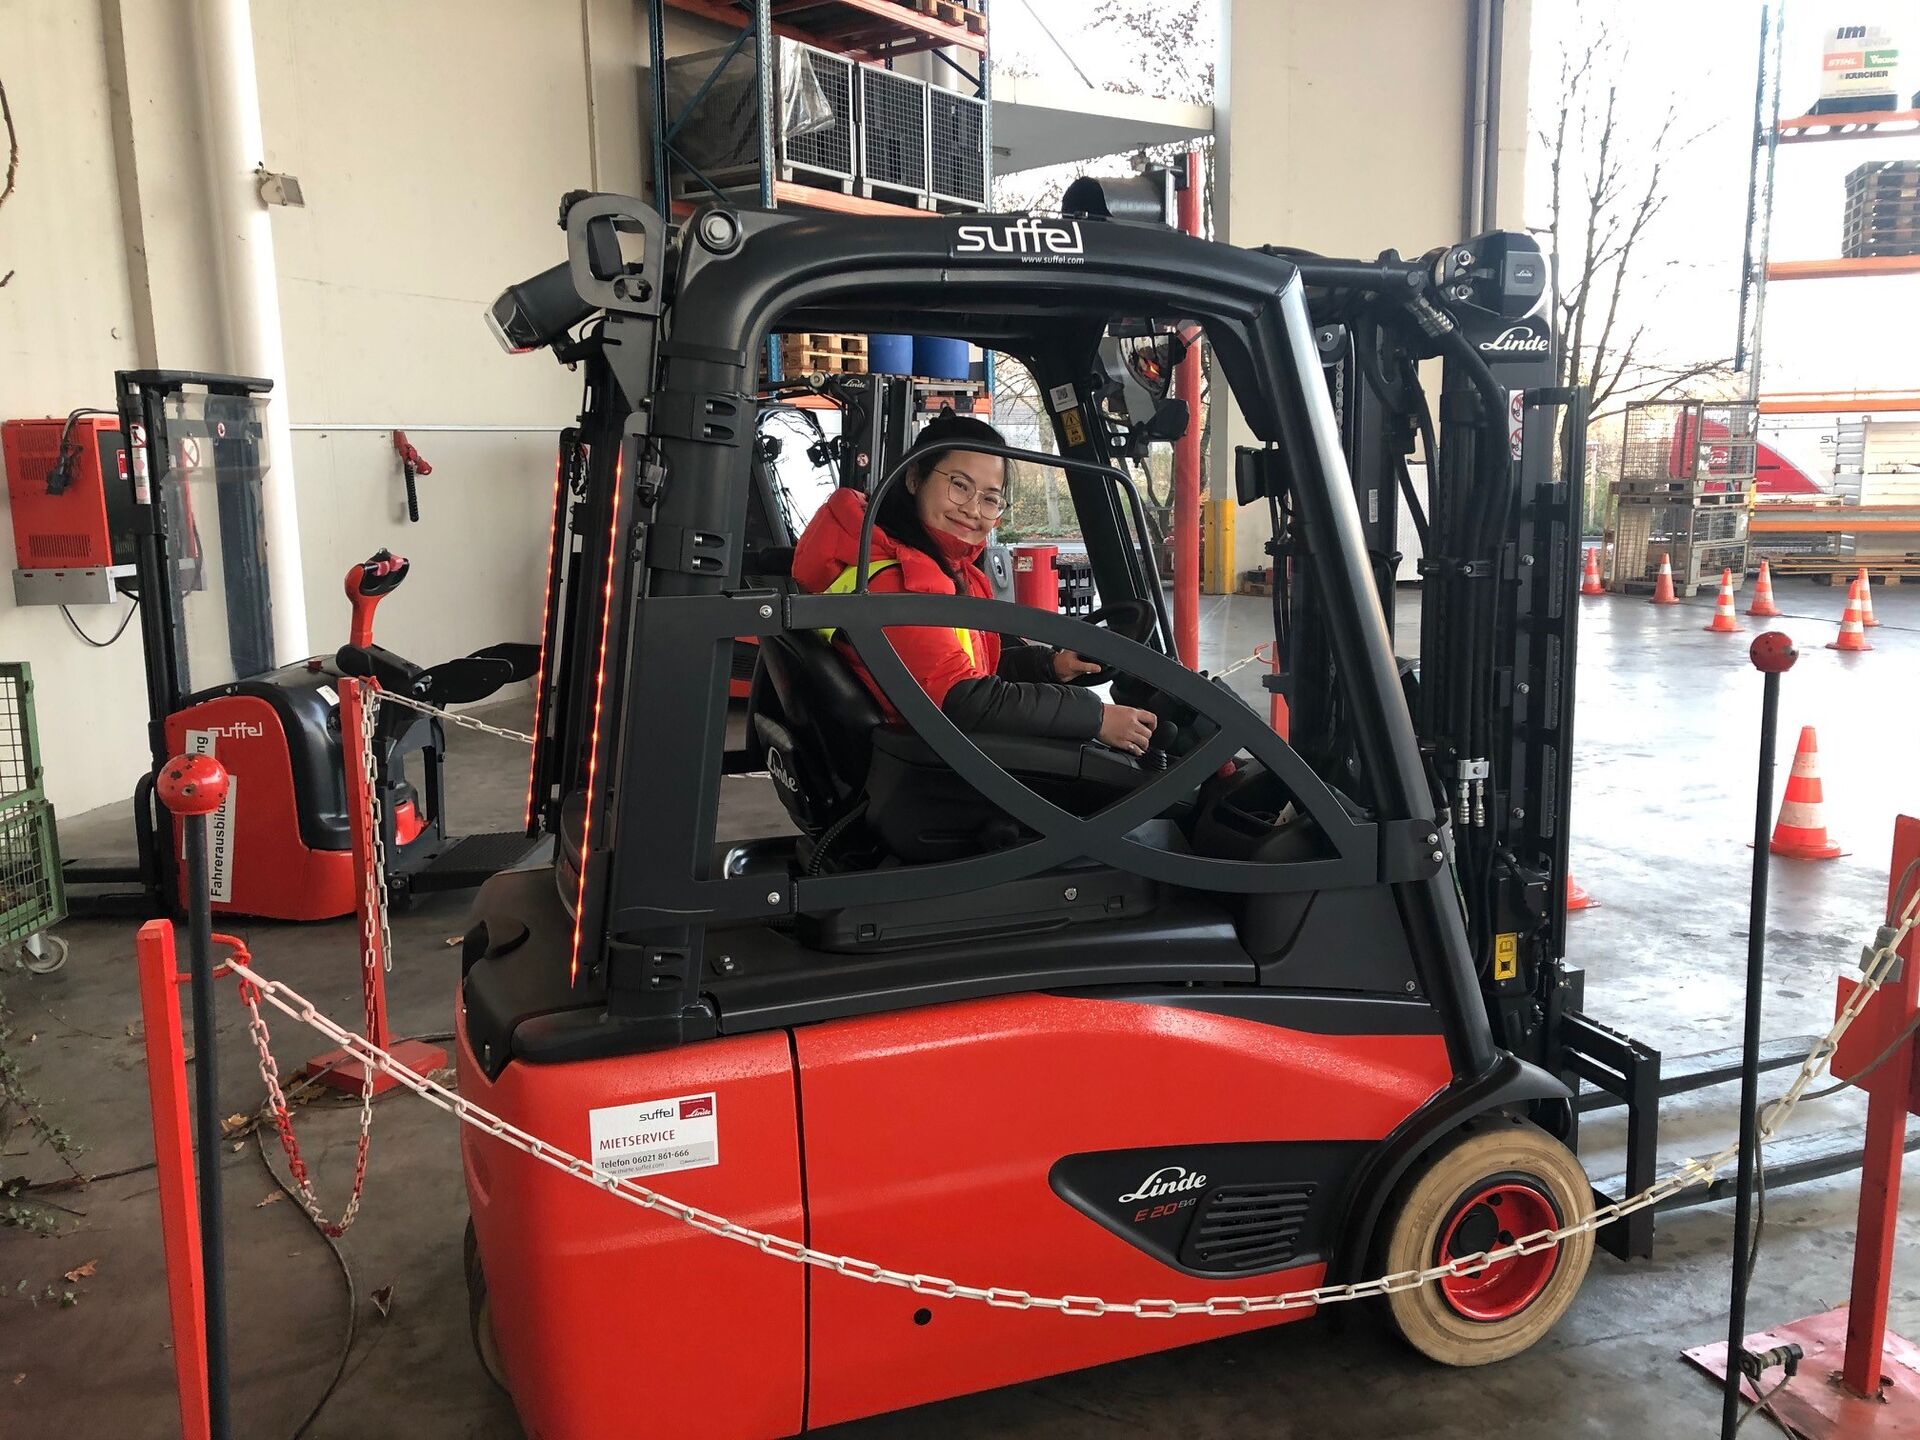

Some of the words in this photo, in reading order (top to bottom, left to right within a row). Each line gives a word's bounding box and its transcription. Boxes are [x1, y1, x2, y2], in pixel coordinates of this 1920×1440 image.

[957, 218, 1084, 254] suffel
[1021, 255, 1085, 264] www.suffel.com
[1479, 326, 1549, 351] Linde
[767, 746, 799, 792] Linde
[211, 797, 227, 897] Fahrerausbild
[639, 1107, 674, 1122] suffel
[600, 1129, 676, 1150] MIETSERVICE
[601, 1157, 630, 1169] Telefon
[632, 1154, 656, 1165] 06021
[658, 1148, 690, 1161] 861-666
[1118, 1166, 1207, 1203] Linde
[1135, 1208, 1150, 1222] E
